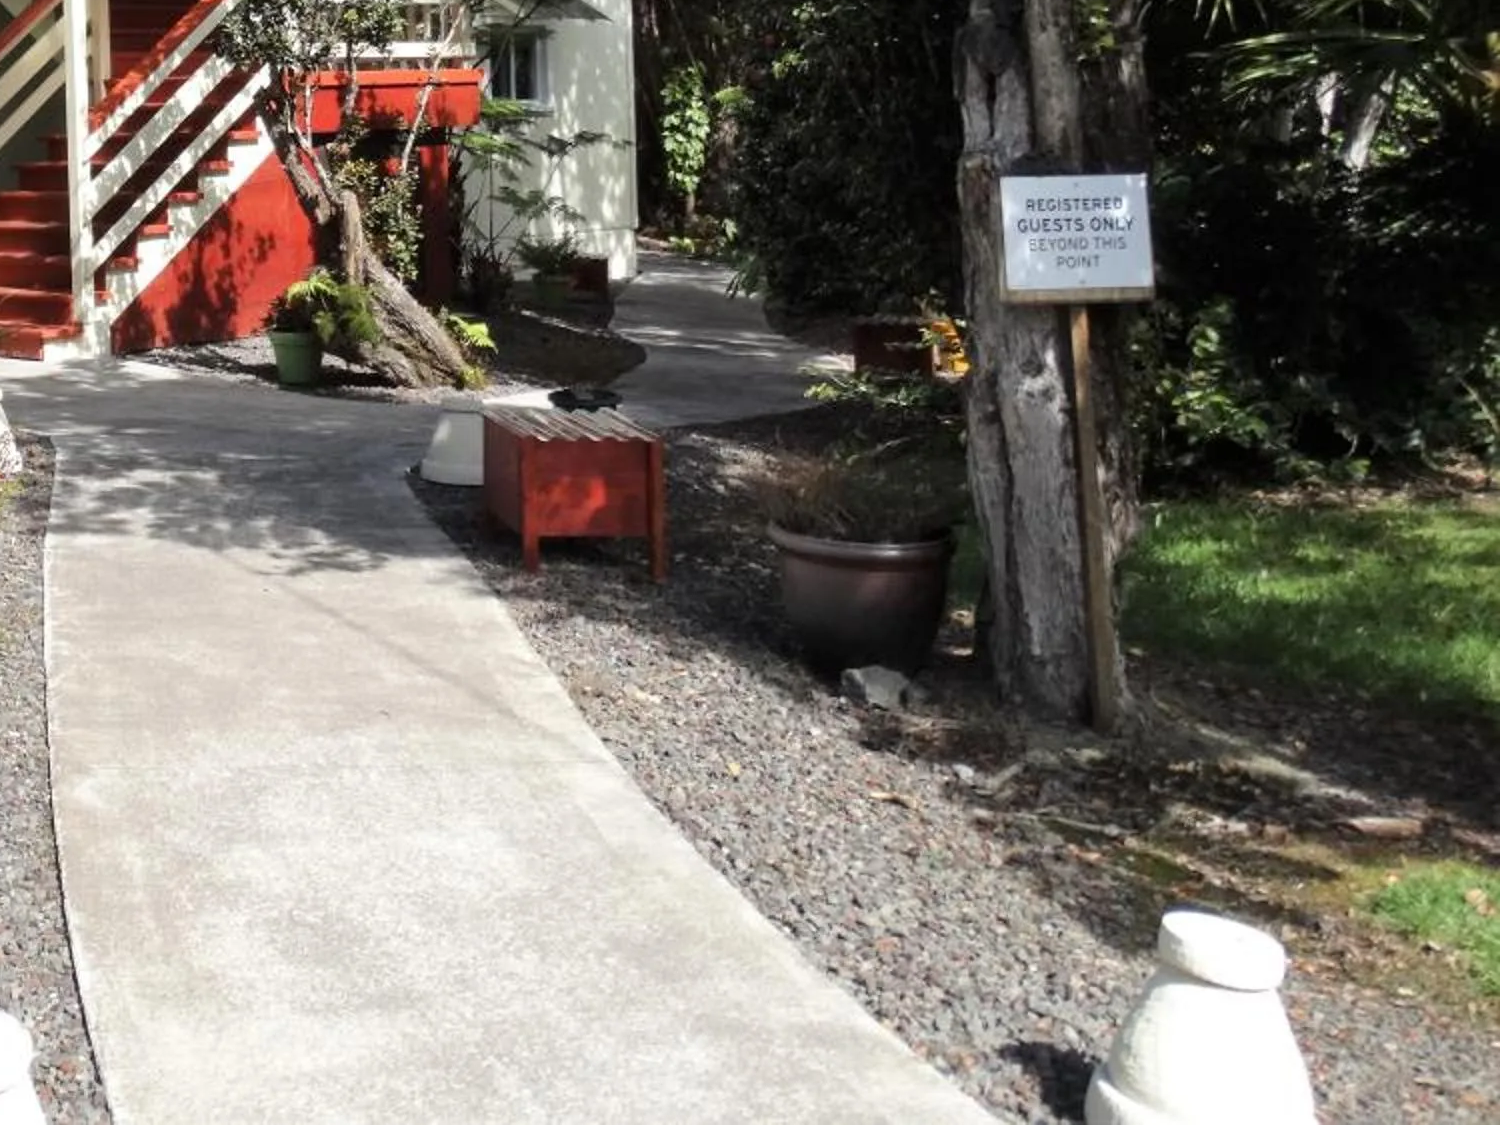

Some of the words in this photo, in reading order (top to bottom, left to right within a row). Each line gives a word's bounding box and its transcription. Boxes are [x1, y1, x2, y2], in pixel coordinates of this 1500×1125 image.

[1025, 197, 1123, 212] REGISTERED
[1017, 218, 1085, 233] GUESTS
[1090, 216, 1134, 232] ONLY
[1028, 237, 1088, 252] BEYOND
[1095, 236, 1127, 250] THIS
[1056, 255, 1100, 269] POINT
